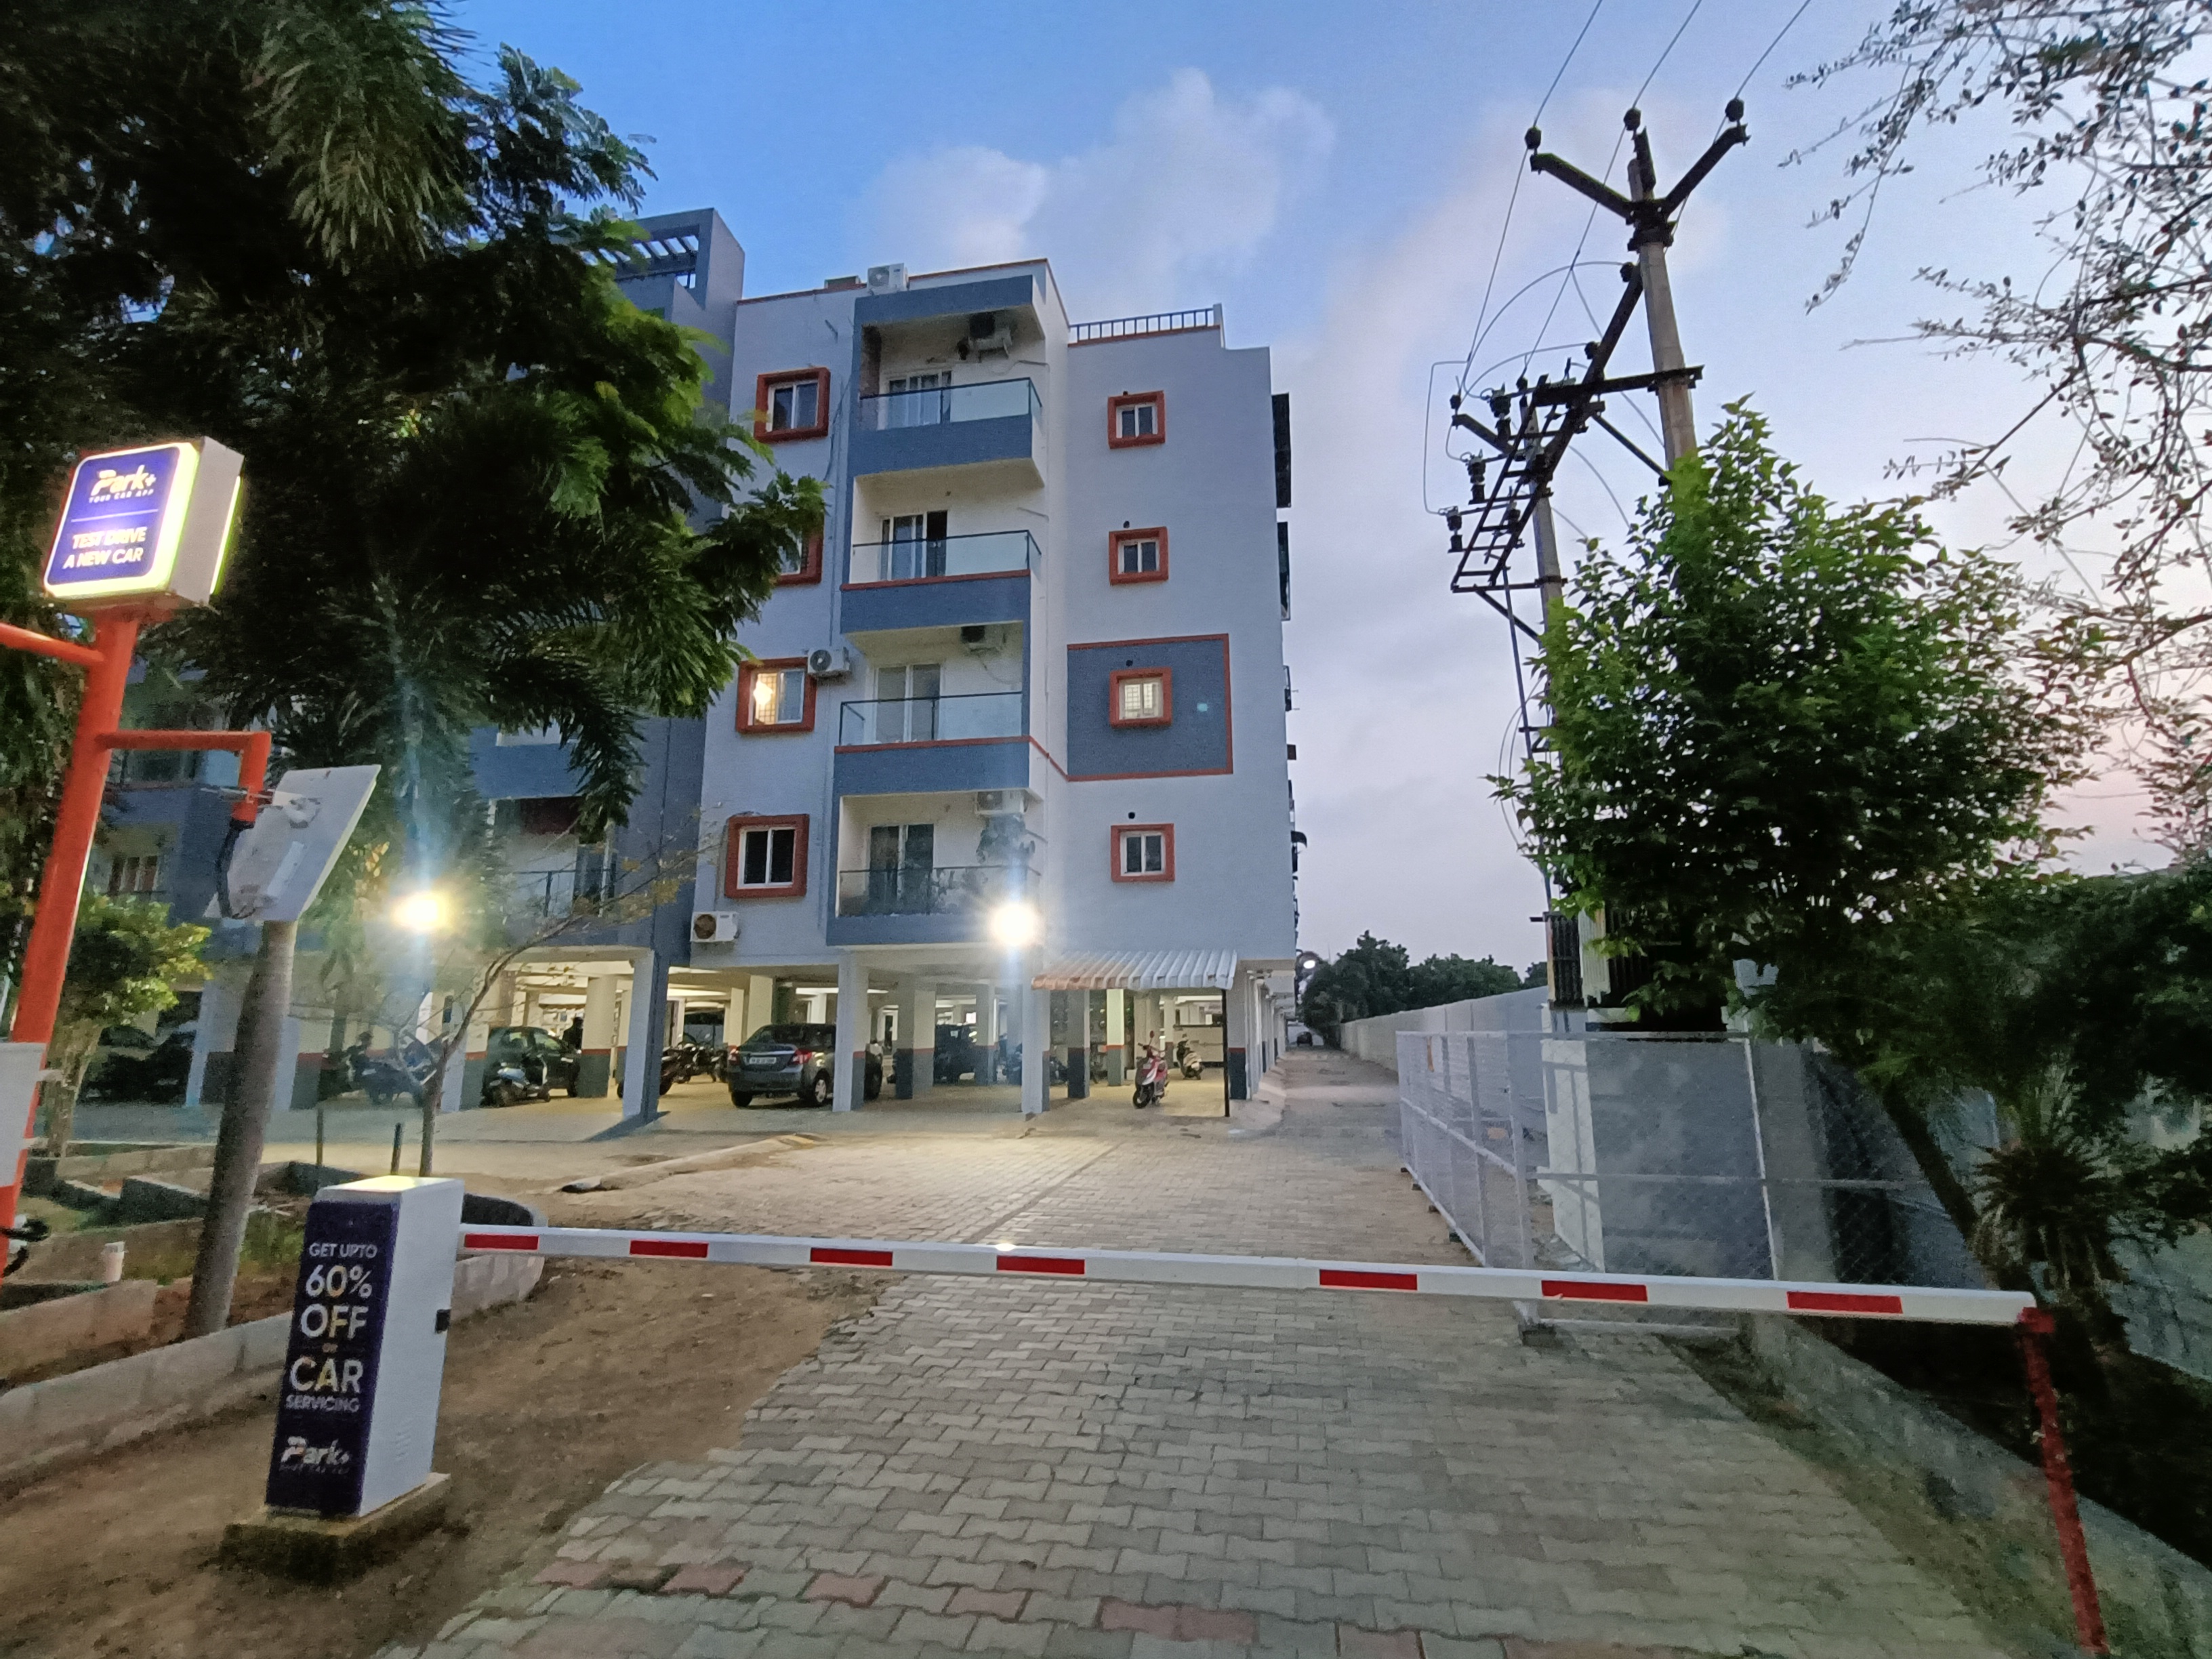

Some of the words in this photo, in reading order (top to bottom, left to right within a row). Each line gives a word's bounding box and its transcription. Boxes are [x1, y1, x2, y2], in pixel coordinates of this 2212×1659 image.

[73, 531, 106, 550] TEST
[103, 527, 147, 546] DRIVE
[63, 554, 75, 569] A
[76, 550, 112, 567] NEW
[112, 547, 144, 564] CAR
[309, 1242, 338, 1257] GET
[340, 1244, 377, 1258] UPTO
[306, 1265, 373, 1298] 60%
[301, 1303, 369, 1339] OFF
[289, 1355, 363, 1393] CAR
[286, 1395, 360, 1412] SERVICING
